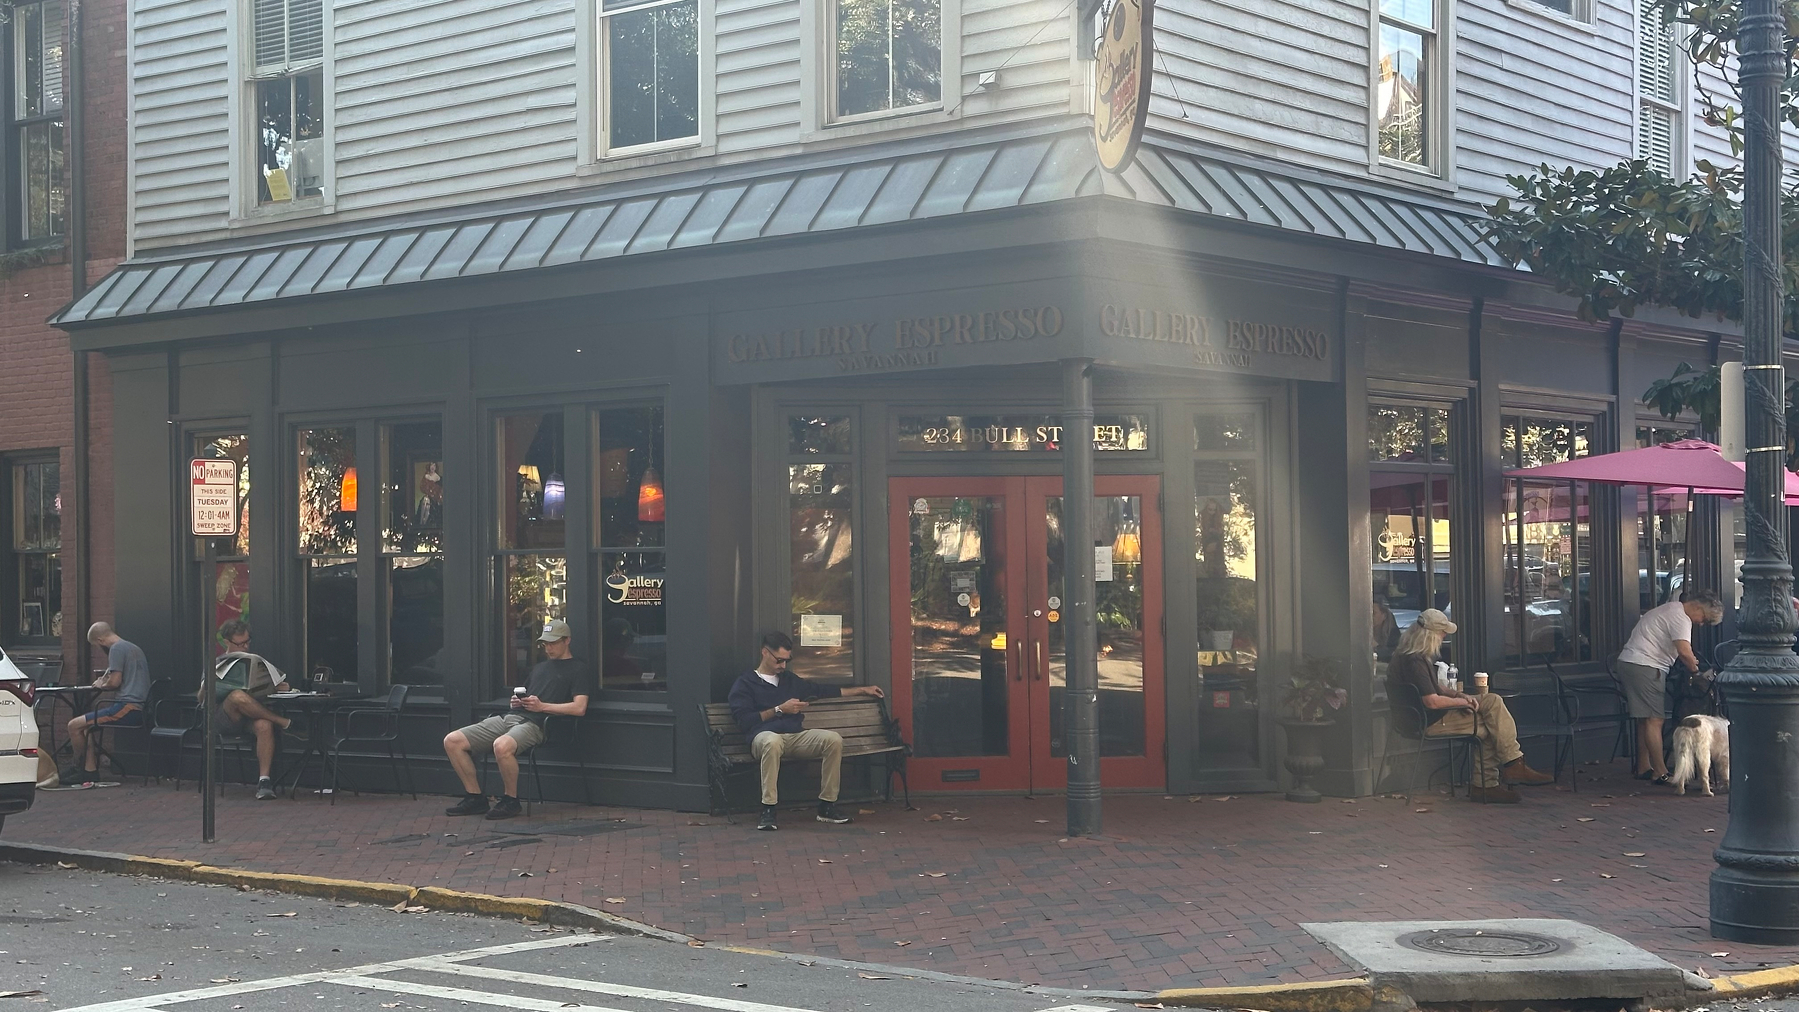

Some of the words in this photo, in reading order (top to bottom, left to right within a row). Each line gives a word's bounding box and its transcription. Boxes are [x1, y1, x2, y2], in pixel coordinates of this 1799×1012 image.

[728, 322, 876, 363] GALLERY
[895, 305, 1064, 350] ESPRESSO
[1099, 303, 1213, 346] GALLERY
[1227, 319, 1329, 361] ESPRESSO
[837, 350, 938, 371] SAVANNAH
[1196, 351, 1252, 367] SAVANNAH
[926, 427, 962, 444] 234
[971, 426, 1029, 444] BULL
[1036, 425, 1122, 443] STET
[193, 465, 205, 479] NO
[206, 468, 233, 479] PARKING
[627, 588, 661, 600] espresso
